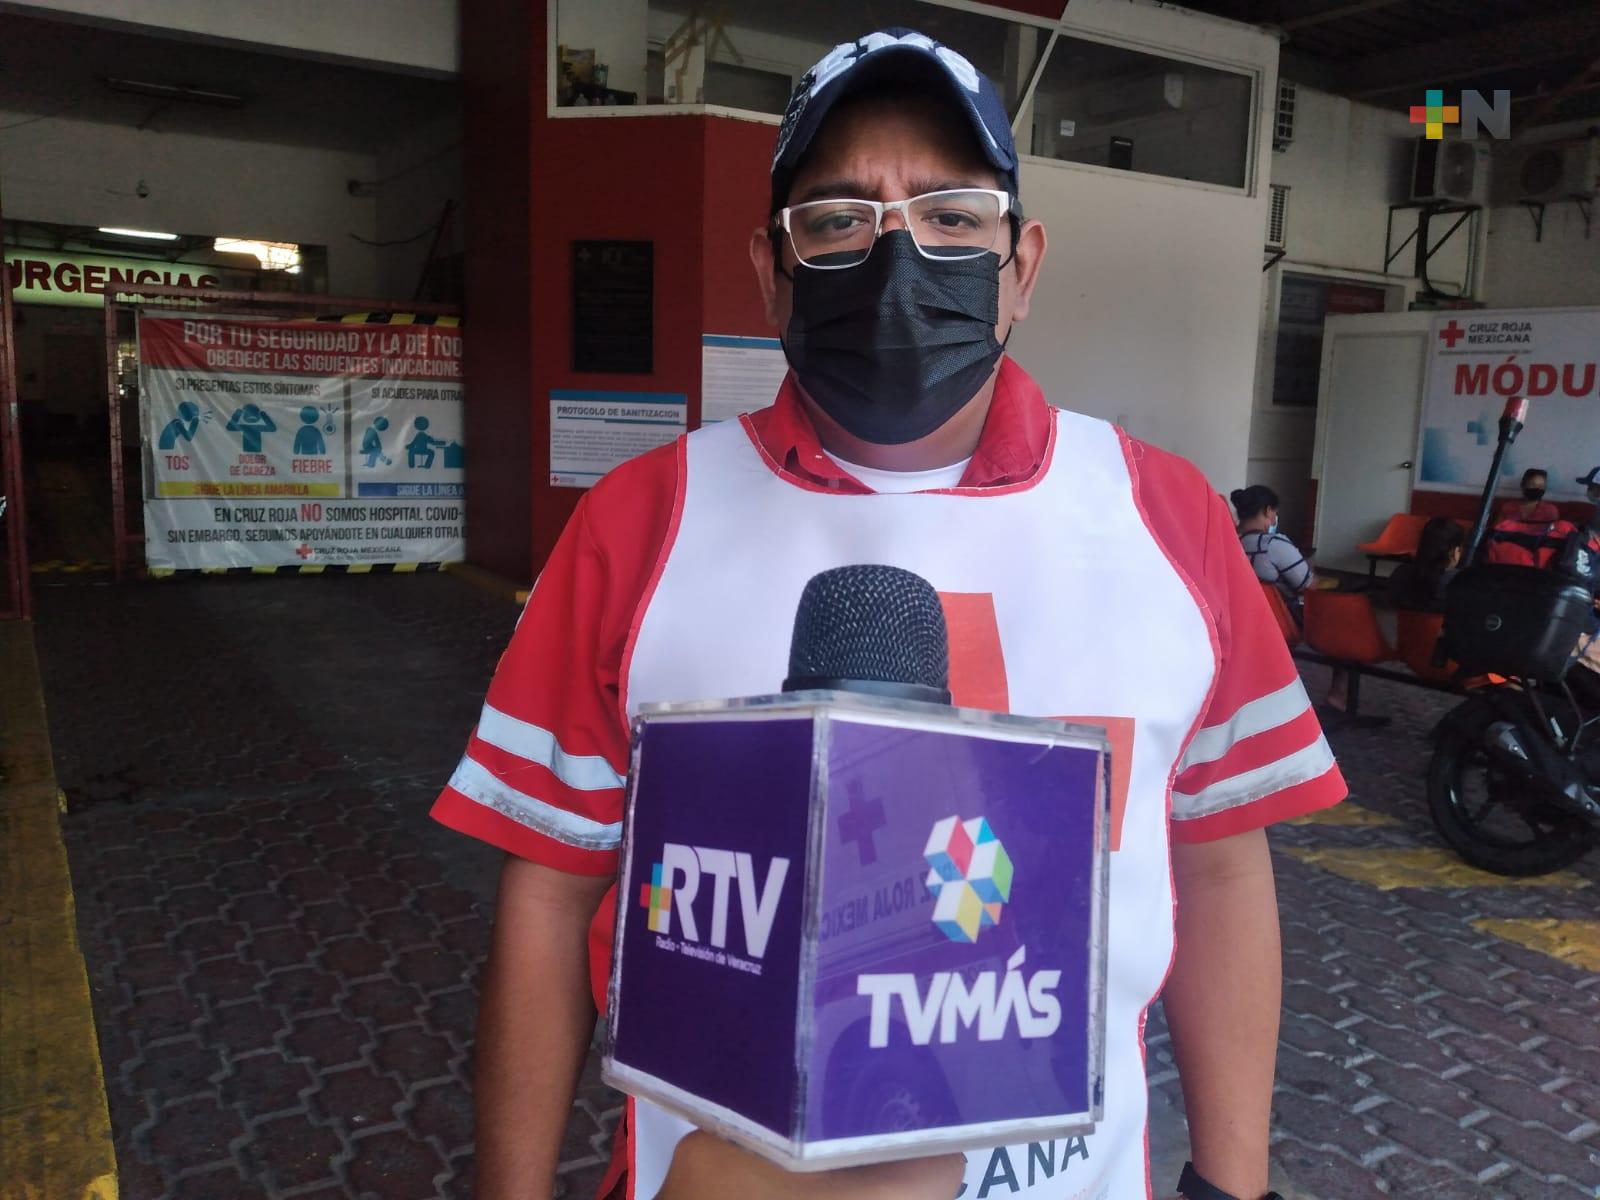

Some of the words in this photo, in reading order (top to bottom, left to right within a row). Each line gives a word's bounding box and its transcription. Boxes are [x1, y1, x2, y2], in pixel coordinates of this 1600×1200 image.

[1468, 322, 1500, 333] CRUZ
[1501, 322, 1532, 332] ROJA
[183, 321, 223, 345] POR
[228, 325, 251, 346] TU
[257, 328, 360, 352] SEGURIDAD
[364, 332, 377, 353] Y
[380, 333, 400, 354] LA
[405, 334, 428, 355] DE
[1468, 333, 1531, 344] MEXICANA
[206, 348, 271, 369] OBEDECE
[274, 352, 300, 370] LAS
[303, 354, 378, 373] SIGUIENTES
[1454, 355, 1600, 397] MÓDU
[186, 378, 241, 393] PRESENTAS
[242, 381, 272, 394] ESTOS
[382, 387, 416, 400] ACUDES
[416, 388, 439, 401] PARA
[557, 406, 606, 416] PROTOCOLO
[607, 407, 619, 416] DE
[165, 455, 190, 470] TOS
[292, 459, 333, 473] FIEBRE
[230, 465, 241, 476] DE
[243, 465, 276, 477] CABEZA
[396, 484, 421, 496] SIGUE
[422, 485, 433, 496] LA
[214, 507, 231, 522] EN
[234, 507, 266, 522] CRUZ
[268, 507, 298, 522] ROJA
[301, 503, 322, 522] NO
[326, 507, 367, 522] SOMOS
[369, 507, 423, 521] HOSPITAL
[167, 529, 186, 543] SIN
[245, 528, 297, 542] SEGUIMOS
[298, 524, 364, 541] APOYÁNDOTE
[365, 527, 379, 540] EN
[380, 527, 433, 540] CUALQUIER
[434, 527, 459, 539] OTRA
[313, 546, 336, 554] CRUZ
[337, 546, 359, 554] ROJA
[659, 842, 790, 959] RTV
